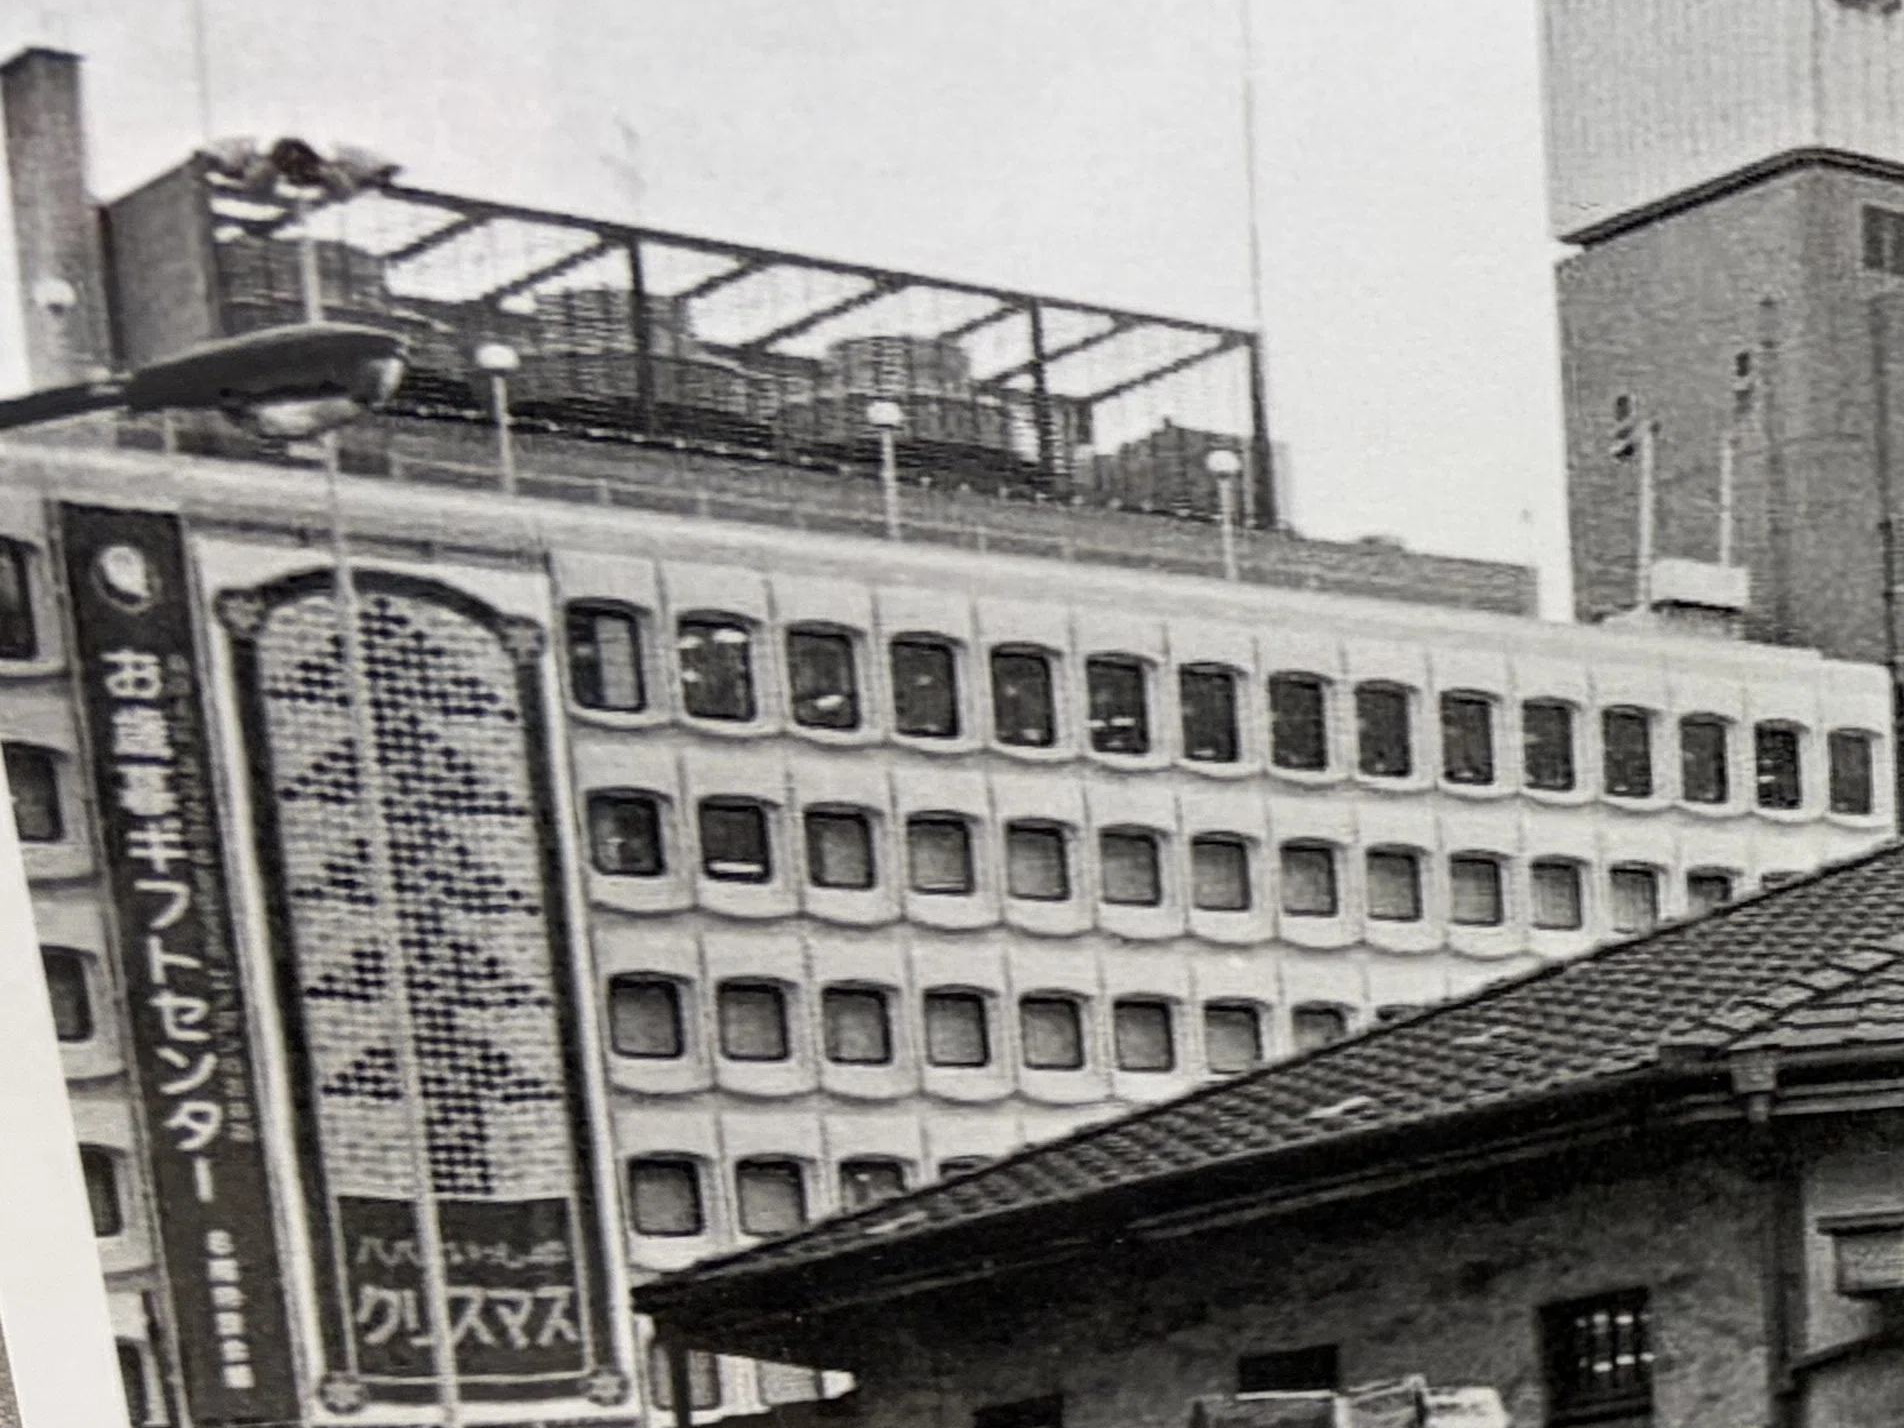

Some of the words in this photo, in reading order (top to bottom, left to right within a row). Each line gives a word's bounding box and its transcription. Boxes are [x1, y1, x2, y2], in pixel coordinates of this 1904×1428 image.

[357, 1282, 581, 1350] クリスマス
